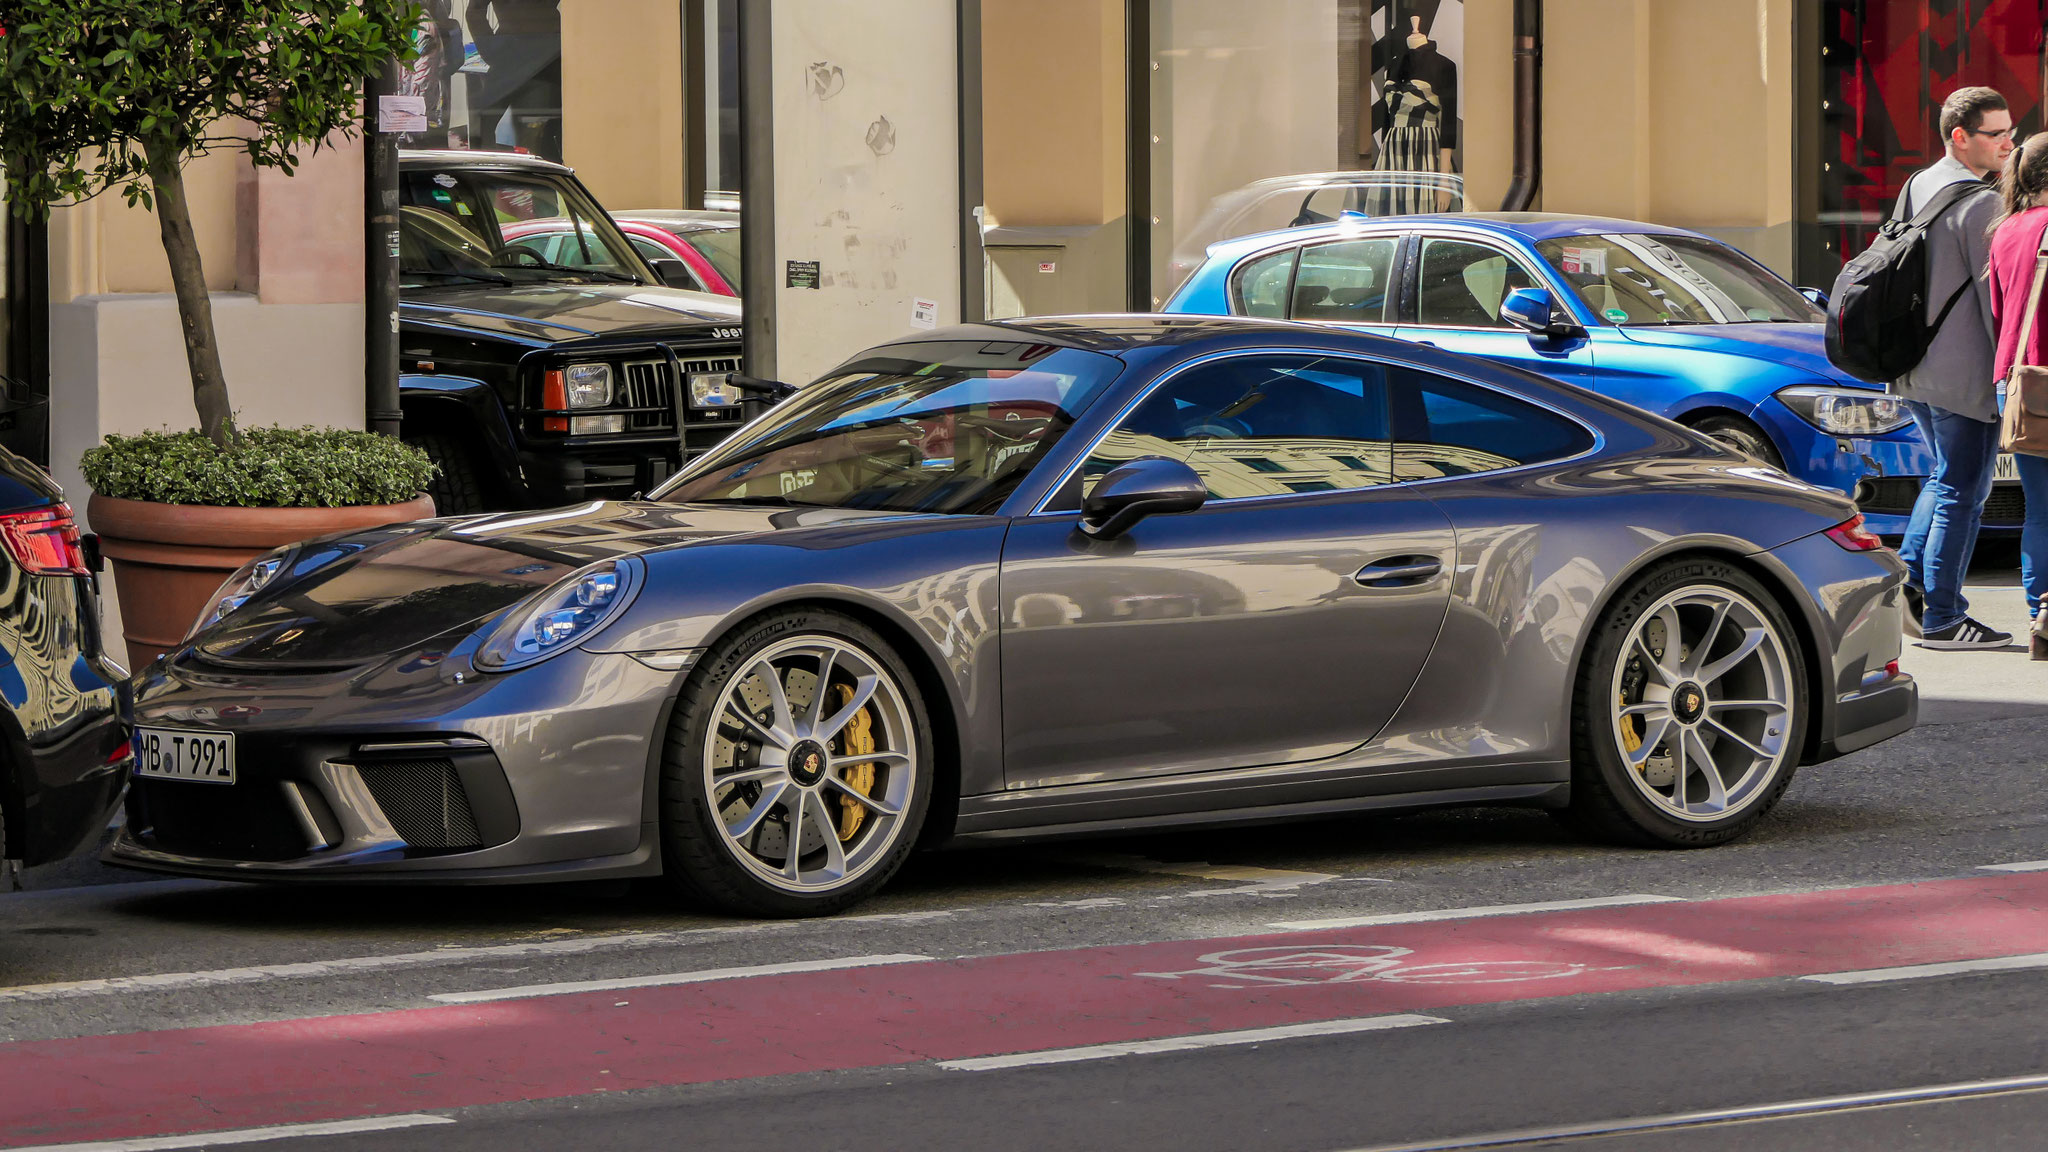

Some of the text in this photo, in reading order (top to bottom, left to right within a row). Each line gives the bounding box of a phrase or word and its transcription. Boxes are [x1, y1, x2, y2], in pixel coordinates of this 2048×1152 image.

[712, 327, 743, 339] Jee
[738, 622, 785, 653] MICHELIN
[172, 736, 185, 774] T
[190, 738, 231, 777] 991
